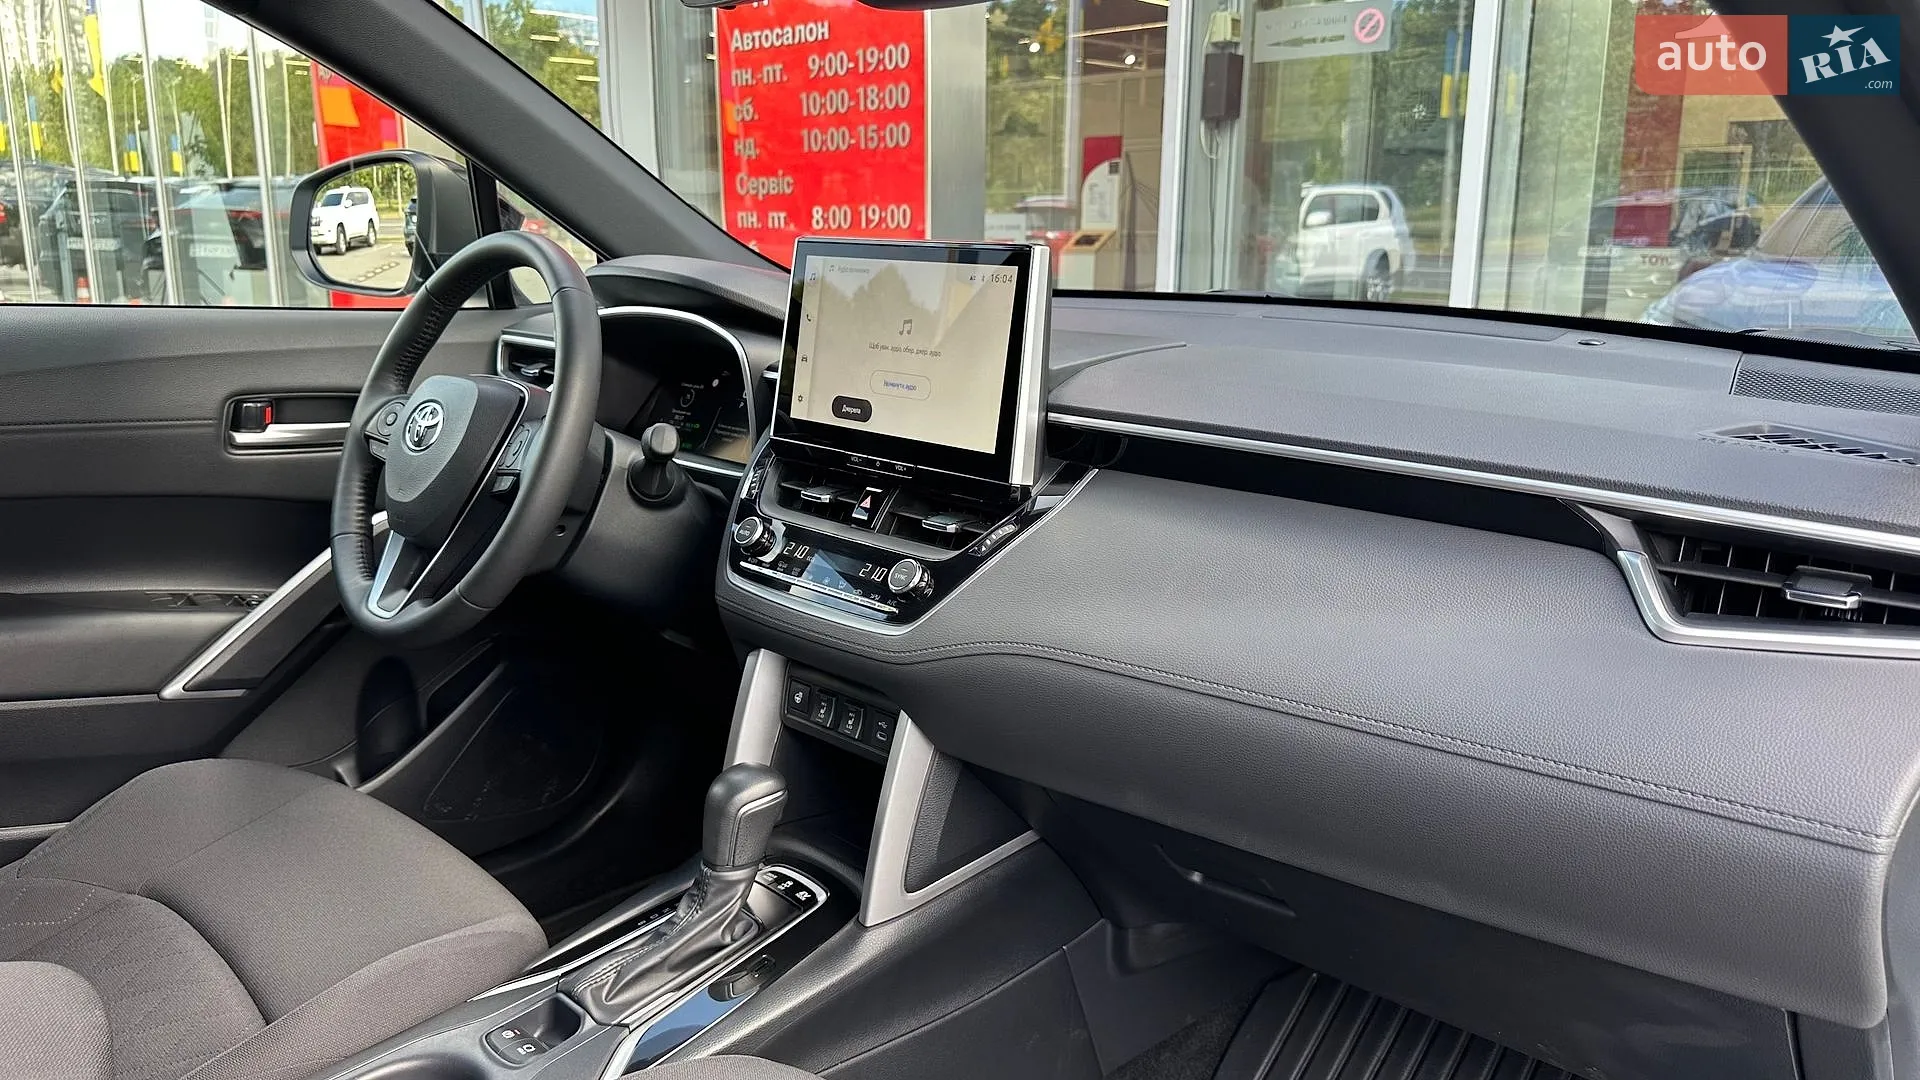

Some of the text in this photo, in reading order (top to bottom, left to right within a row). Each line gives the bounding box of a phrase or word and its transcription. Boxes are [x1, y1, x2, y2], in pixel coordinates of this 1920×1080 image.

[731, 20, 829, 51] Автосалон
[807, 43, 910, 79] 9:00-19:00
[733, 83, 910, 122] сб. 10:00-18:00
[801, 122, 910, 153] 10:00-15:00
[736, 170, 794, 200] Сервіс
[812, 205, 851, 229] 8:00
[859, 204, 911, 229] 19:00
[991, 273, 1013, 283] 16:04
